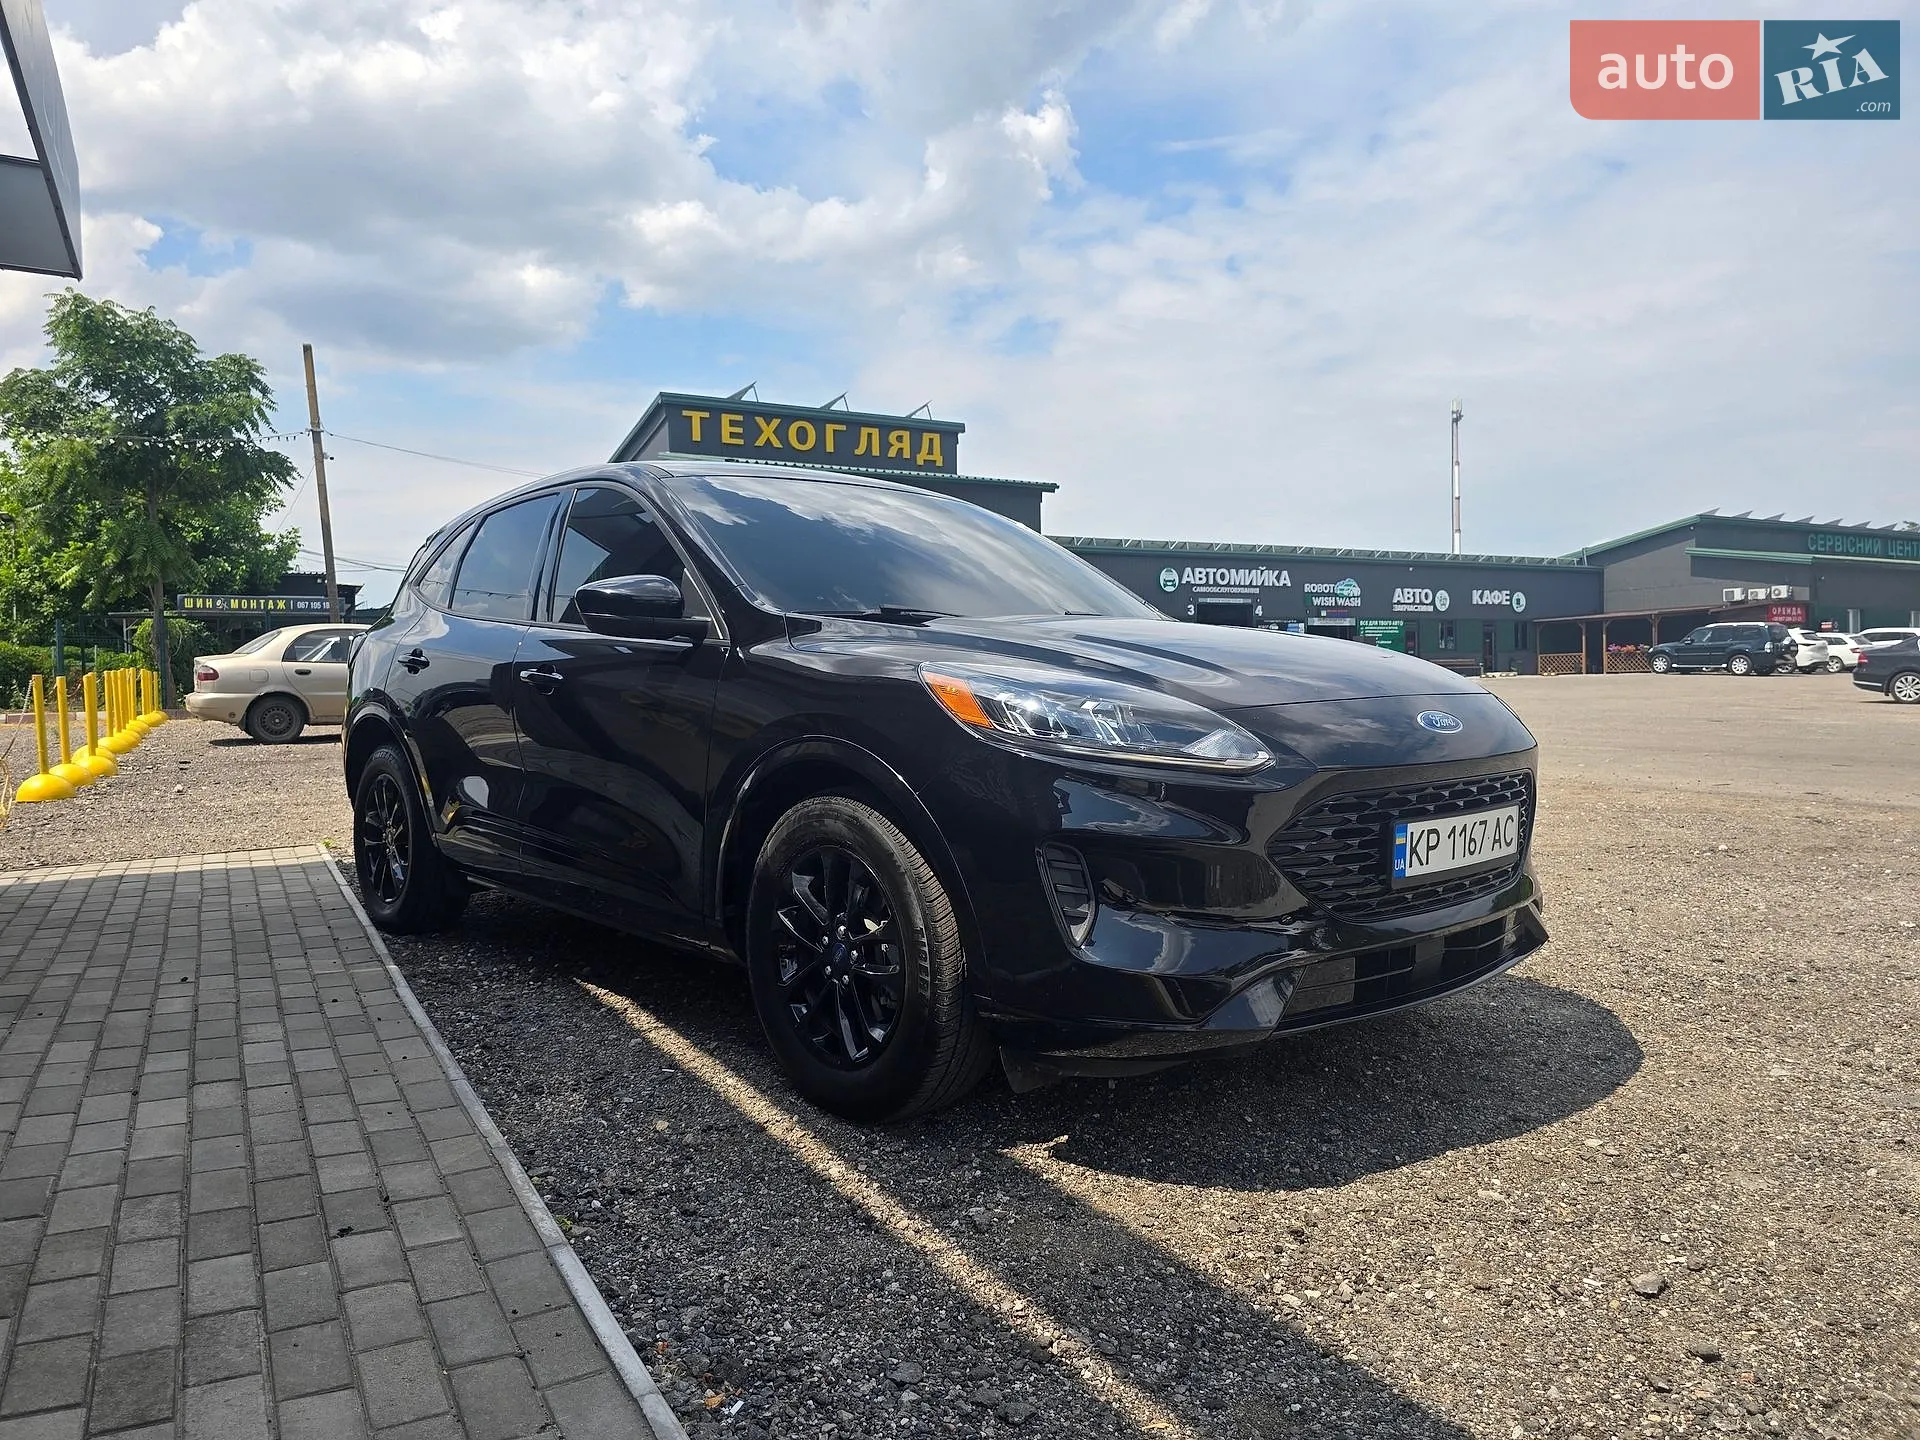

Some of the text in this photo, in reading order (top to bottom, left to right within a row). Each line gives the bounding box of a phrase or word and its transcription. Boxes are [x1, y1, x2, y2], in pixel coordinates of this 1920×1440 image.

[682, 409, 944, 466] ТЕХОГЛЯД
[1807, 533, 1880, 555] СЕРВІСНИЙ
[1181, 566, 1291, 586] АВТОМИЙКА
[1304, 583, 1335, 593] ROBOT
[1312, 596, 1361, 607] WISH WASH
[1392, 588, 1433, 604] АВТО
[1472, 590, 1511, 605] КАФЕ
[184, 598, 213, 609] ШИН
[230, 599, 286, 610] МОНТАЖ
[1187, 604, 1195, 616] 3
[1254, 605, 1263, 616] 4
[1771, 607, 1802, 616] ОРЕНДА
[1429, 713, 1456, 727] Ford
[1408, 814, 1514, 868] KP 1167 AC
[1395, 858, 1405, 870] UA
